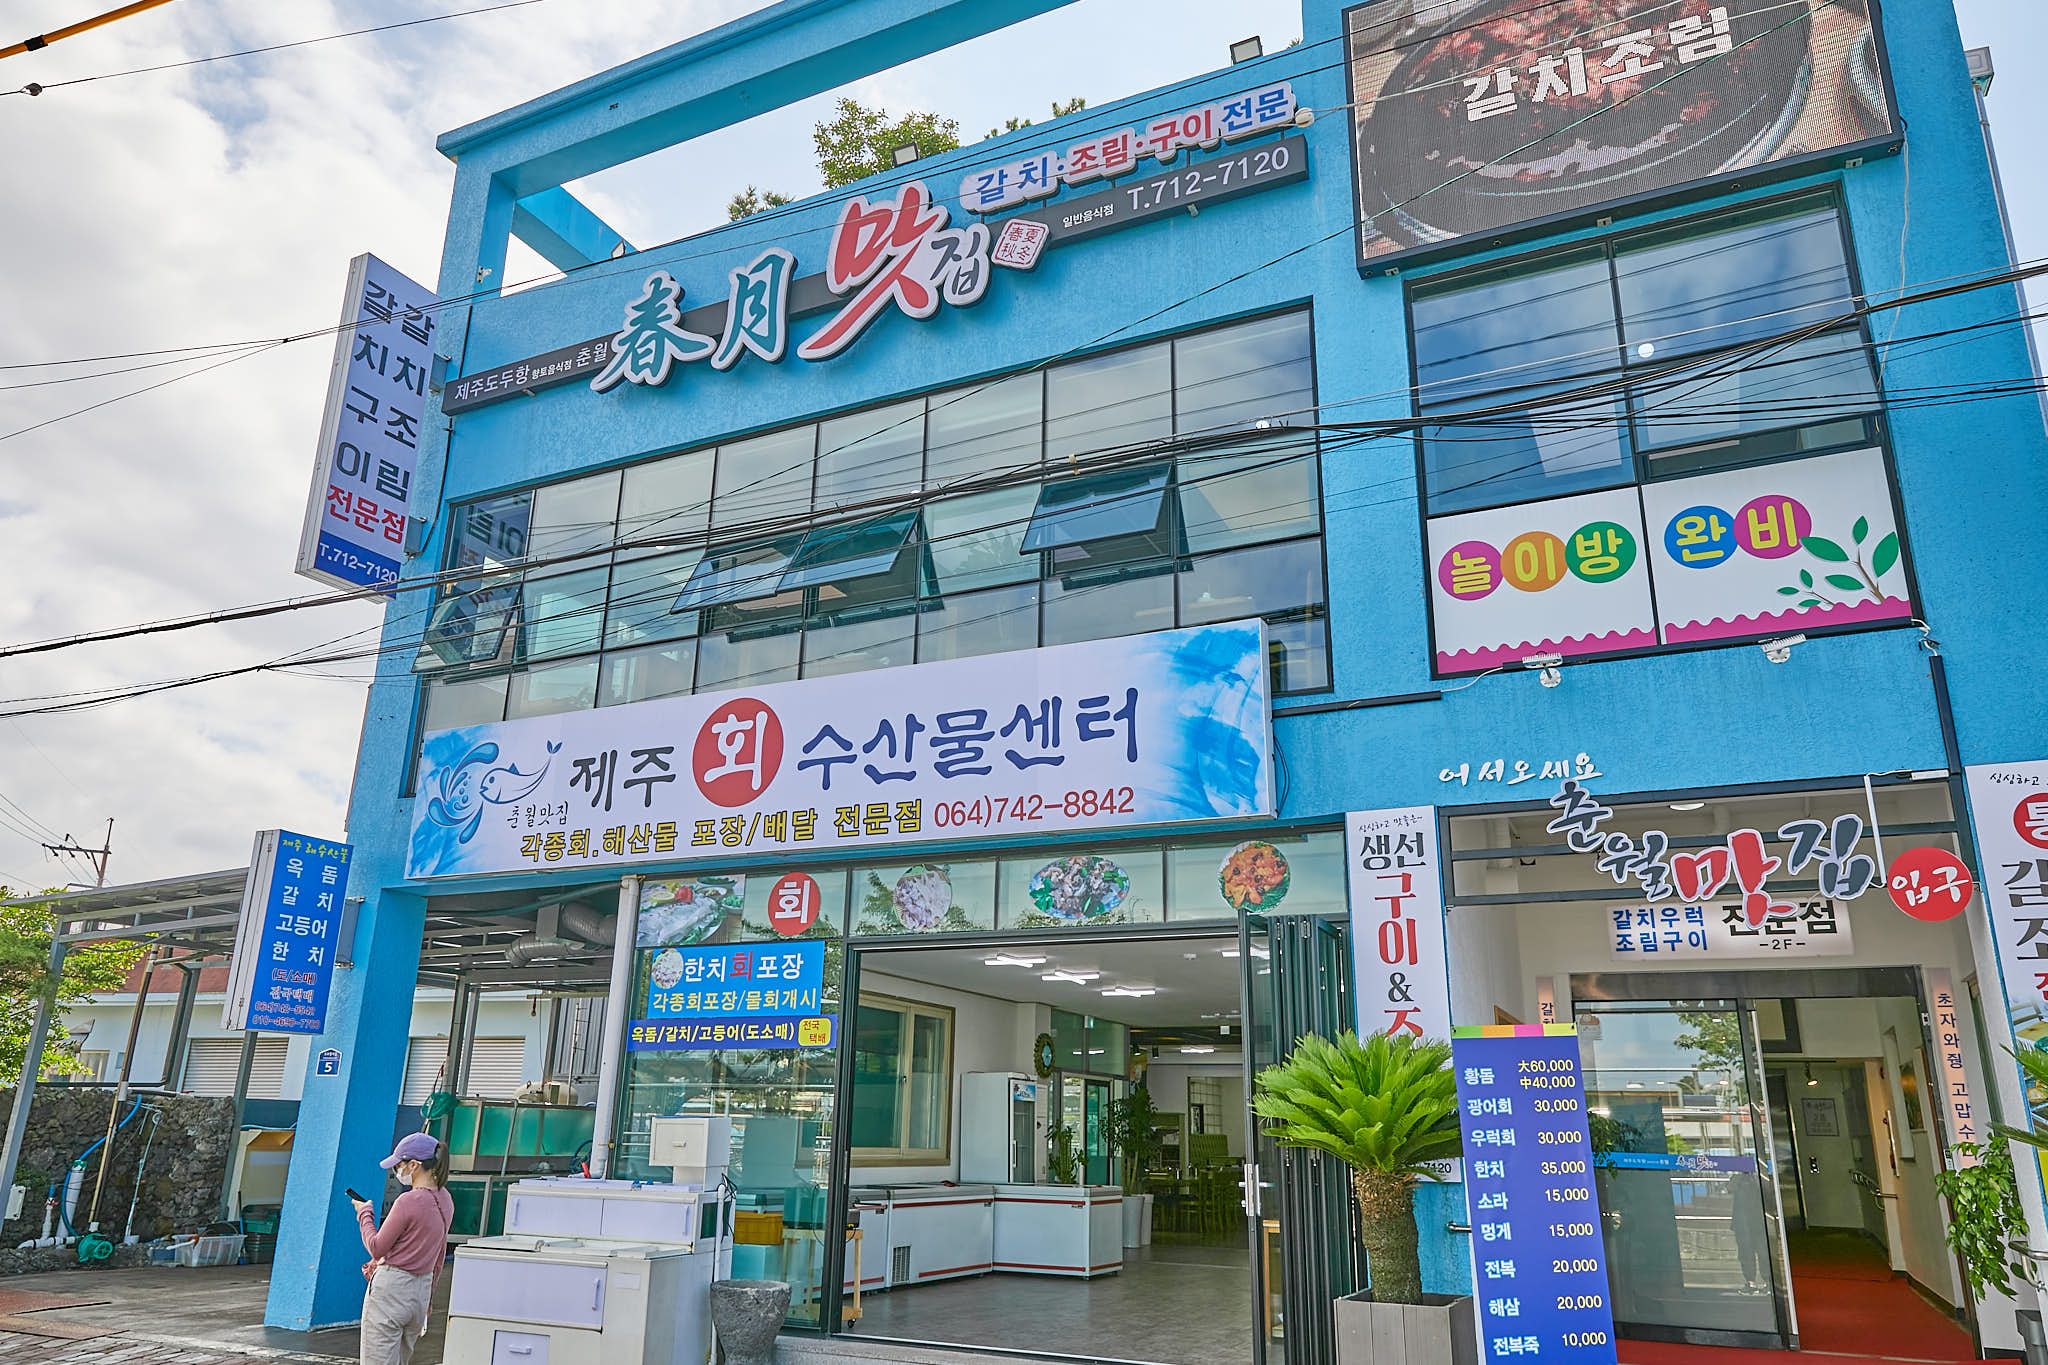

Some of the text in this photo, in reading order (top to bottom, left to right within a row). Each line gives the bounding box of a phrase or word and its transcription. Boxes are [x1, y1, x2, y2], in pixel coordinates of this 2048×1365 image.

[1462, 8, 1733, 122] 갈치조림
[1221, 87, 1289, 133] 전문
[1062, 146, 1290, 228] 일반음식점 T.712-7120
[805, 184, 987, 352] 맛집
[455, 342, 608, 400] 제주도두항 향토음식점 춘월
[327, 484, 405, 544] 전문점
[1451, 500, 1798, 595] 놀이방 완비
[319, 542, 398, 582] T.712-7120
[570, 687, 1138, 811] 제주 회 수산물센터
[1438, 752, 1603, 787] 어서오세요
[507, 800, 569, 829] 춘월맛집
[520, 786, 1135, 862] 각종회.해산물 포장/배달 전문점 064)742-8842
[1360, 832, 1426, 870] 생선
[1892, 864, 1969, 908] 입구
[774, 879, 811, 924] 회
[276, 913, 328, 939] 고등어
[1375, 872, 1417, 966] 구이
[1613, 906, 1704, 930] 갈치우럭
[1616, 930, 1708, 952] 조림구이
[272, 968, 317, 985] (도/소매)
[1388, 972, 1414, 1002] &
[653, 987, 817, 1013] 각종회포장/물회개시
[631, 1022, 795, 1044] 옥돔/갈치/고등어(도소매)
[803, 1020, 819, 1031] 전국
[809, 1033, 826, 1044] 택배
[324, 1062, 333, 1073] 5
[1464, 1059, 1574, 1086] 황돔 大60,000
[1519, 1075, 1576, 1090] 中40,000
[1467, 1097, 1578, 1115] 광어회 30,000
[1471, 1128, 1582, 1147] 우럭회 30,000
[1474, 1160, 1585, 1179] 한치 35,000
[1477, 1187, 1589, 1210] 소라 15,000
[1481, 1222, 1593, 1241] 멍게 15,000
[1484, 1258, 1598, 1278] 전복 20,000
[1488, 1295, 1602, 1317] 해삼 20,000
[1493, 1331, 1607, 1356] 전복죽 10,000
